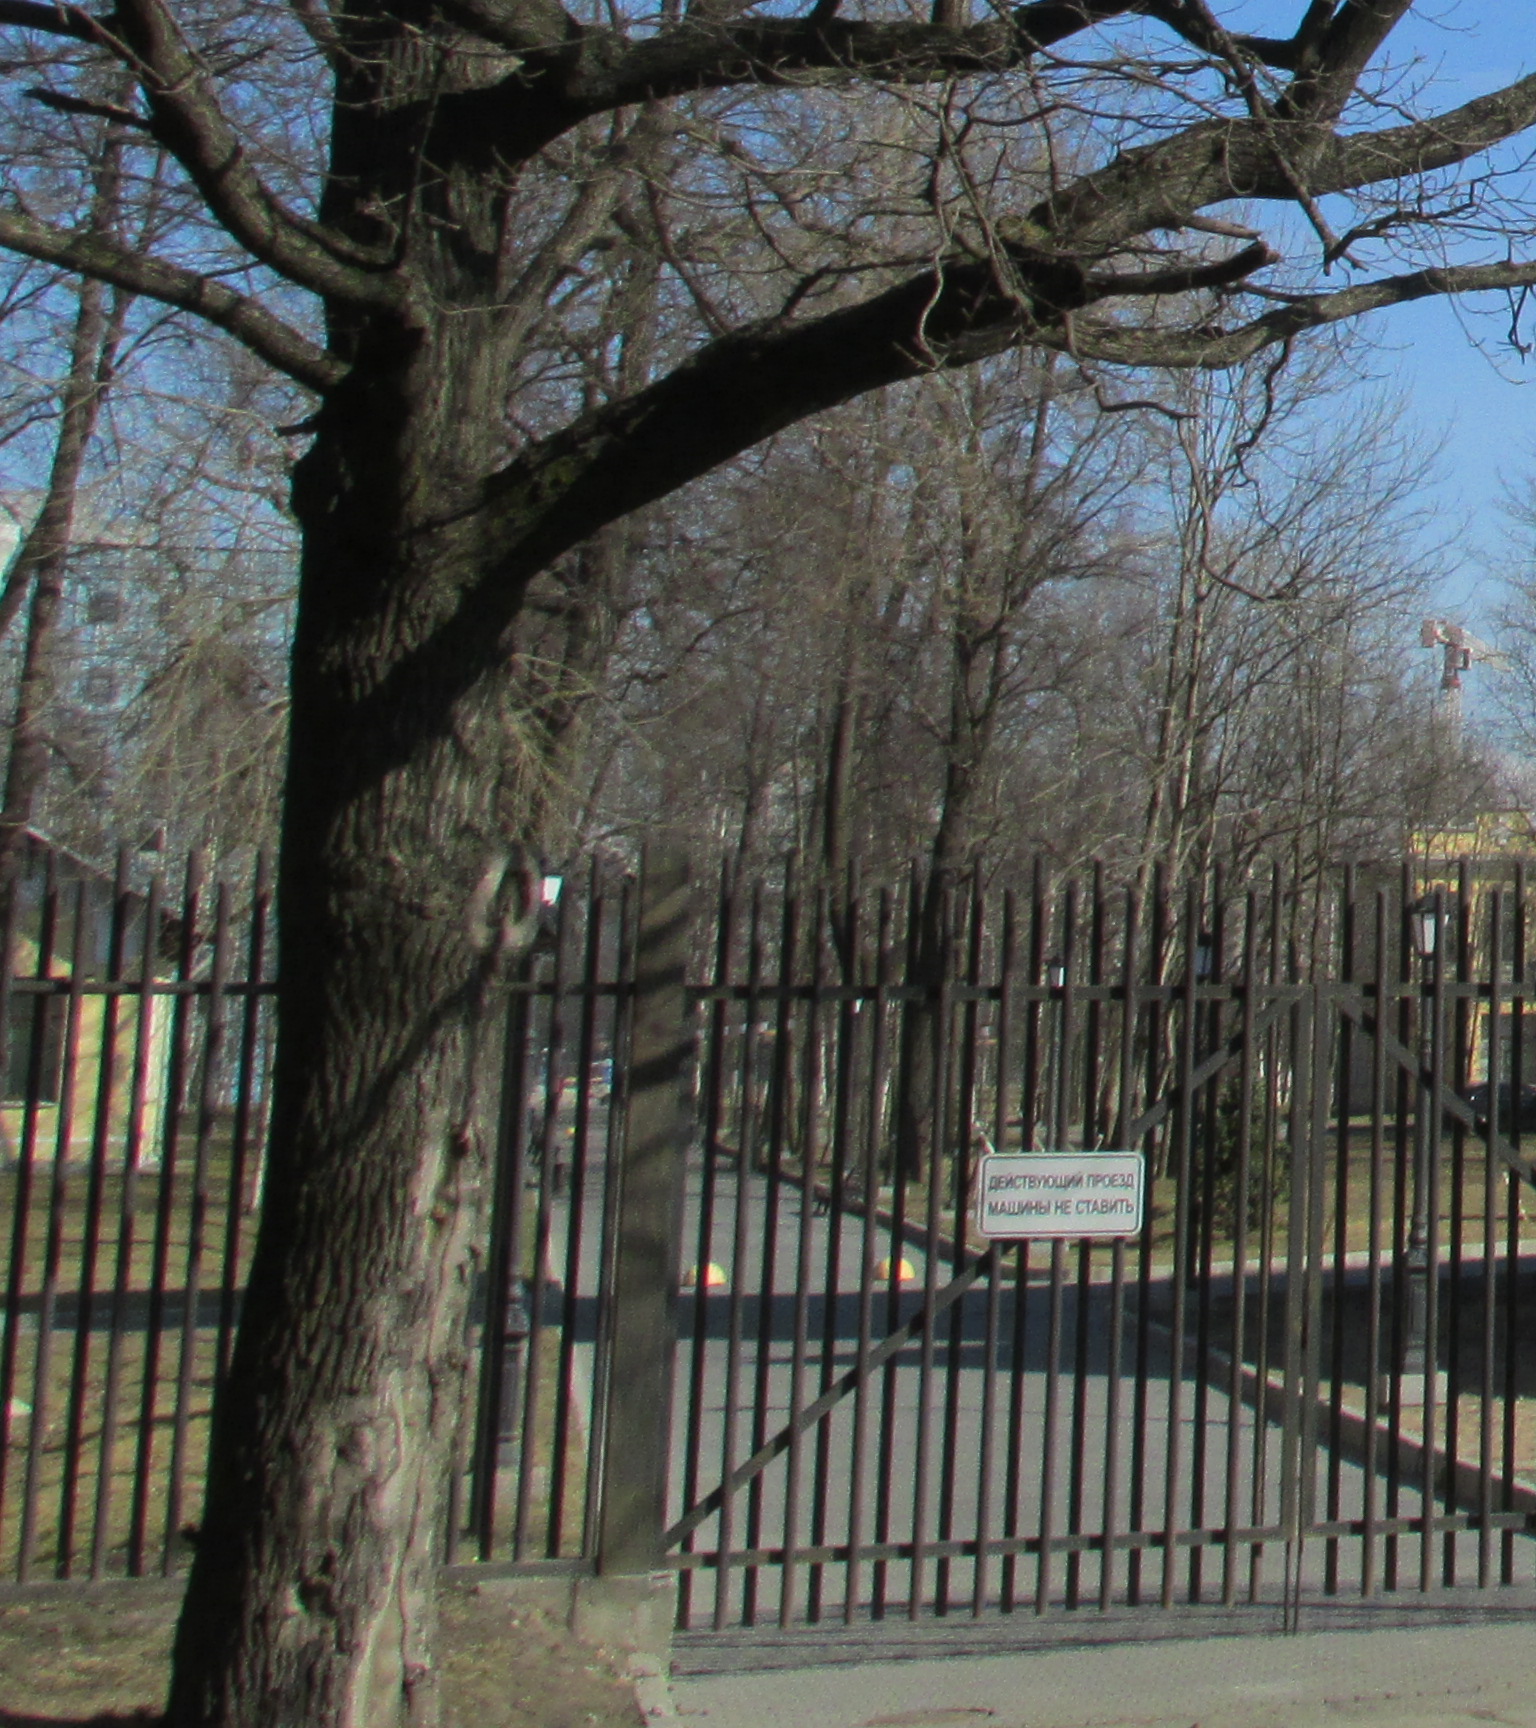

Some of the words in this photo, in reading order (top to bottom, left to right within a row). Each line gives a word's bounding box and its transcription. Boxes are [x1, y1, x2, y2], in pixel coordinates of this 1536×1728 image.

[988, 1172, 1083, 1191] ДЕЙСТВУЮЩИЙ
[1087, 1173, 1134, 1190] ПРОЕЗД
[988, 1200, 1050, 1216] МАШИНЫ
[1054, 1200, 1072, 1214] НЕ
[1075, 1198, 1134, 1215] СТАВИТЬ
